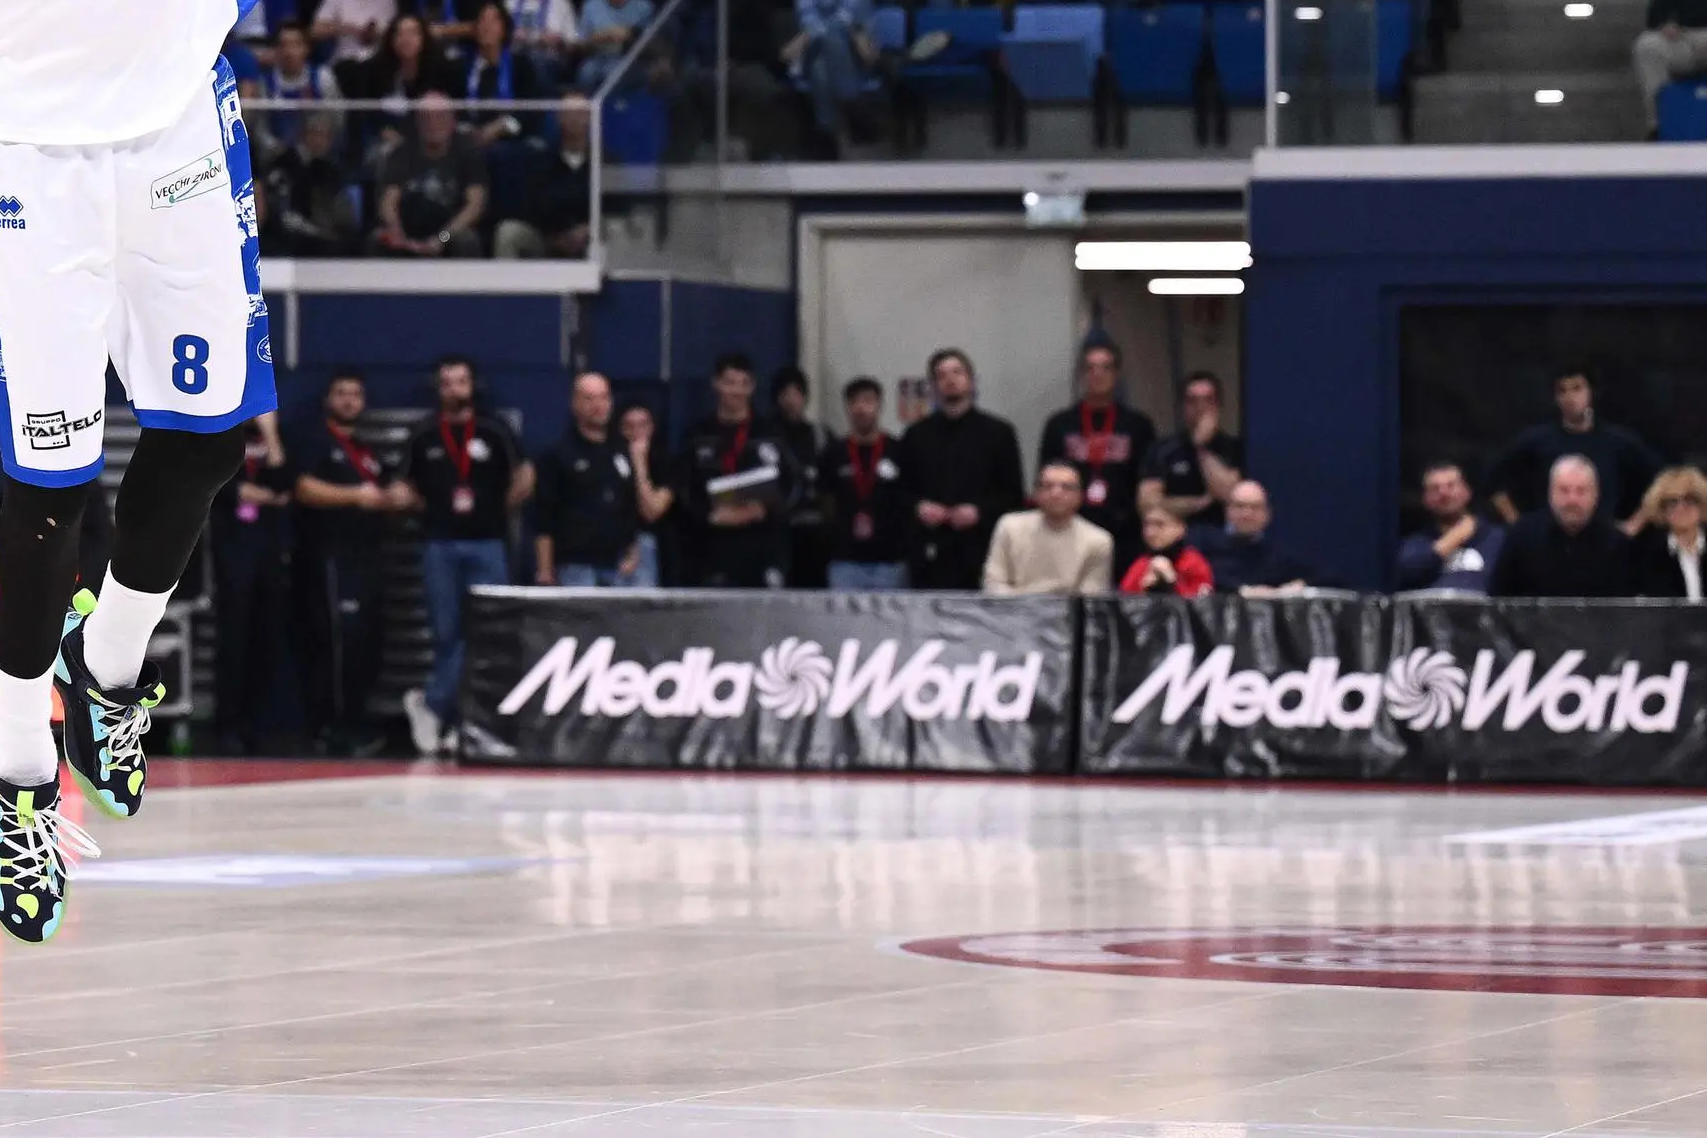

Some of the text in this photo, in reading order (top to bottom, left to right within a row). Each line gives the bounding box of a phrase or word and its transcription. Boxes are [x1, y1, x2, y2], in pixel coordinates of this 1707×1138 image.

[155, 177, 190, 199] VECCHI
[171, 334, 209, 395] 8
[498, 636, 1043, 722] Media World
[1112, 643, 1690, 733] Media World
